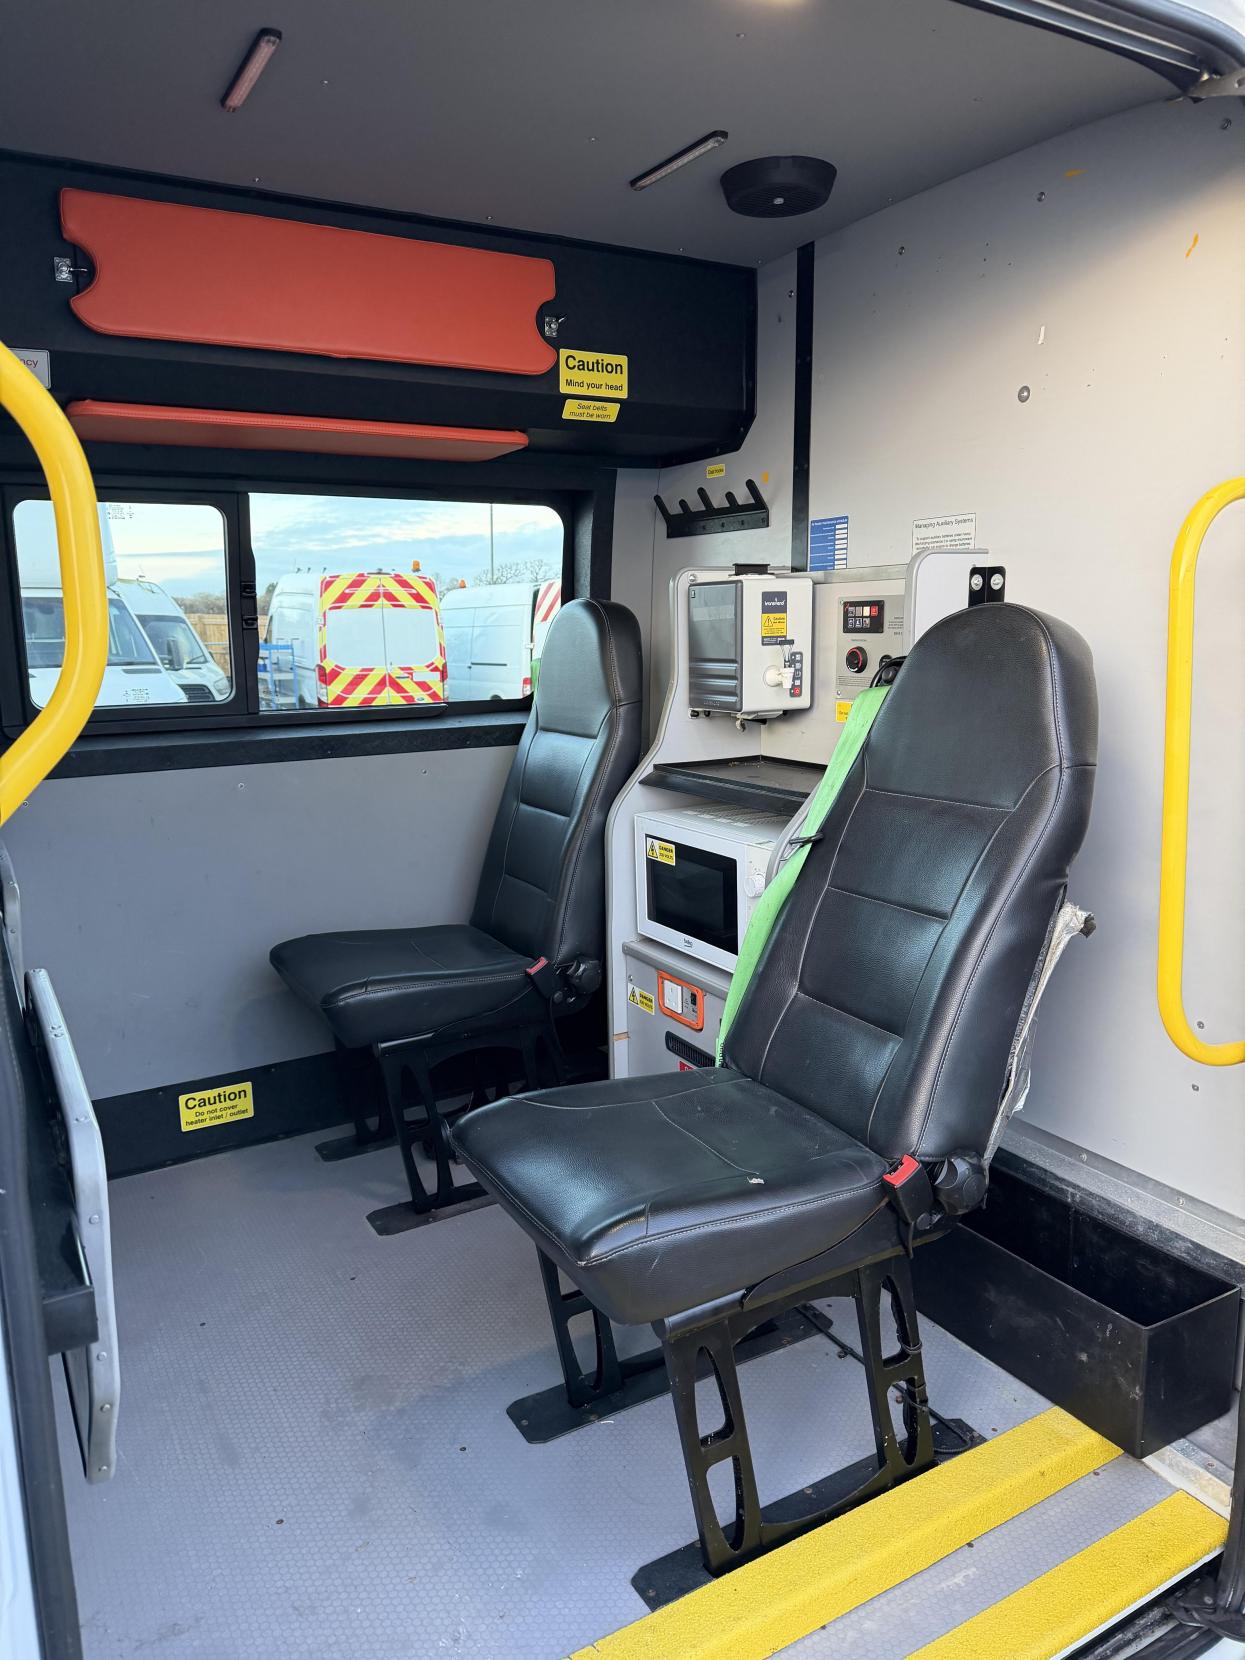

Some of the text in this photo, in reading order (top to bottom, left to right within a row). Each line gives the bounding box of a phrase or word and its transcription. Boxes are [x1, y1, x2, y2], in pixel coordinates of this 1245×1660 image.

[565, 354, 623, 375] Caution
[565, 378, 623, 391] Mind your head
[577, 402, 591, 410] Seat
[569, 410, 585, 418] must
[955, 518, 974, 526] Systems
[658, 845, 674, 853] DANGER
[184, 1089, 247, 1110] Caution
[207, 1107, 218, 1115] not
[219, 1104, 238, 1112] cover
[185, 1117, 208, 1127] heater
[209, 1113, 224, 1122] inlet
[229, 1108, 249, 1117] outlet
